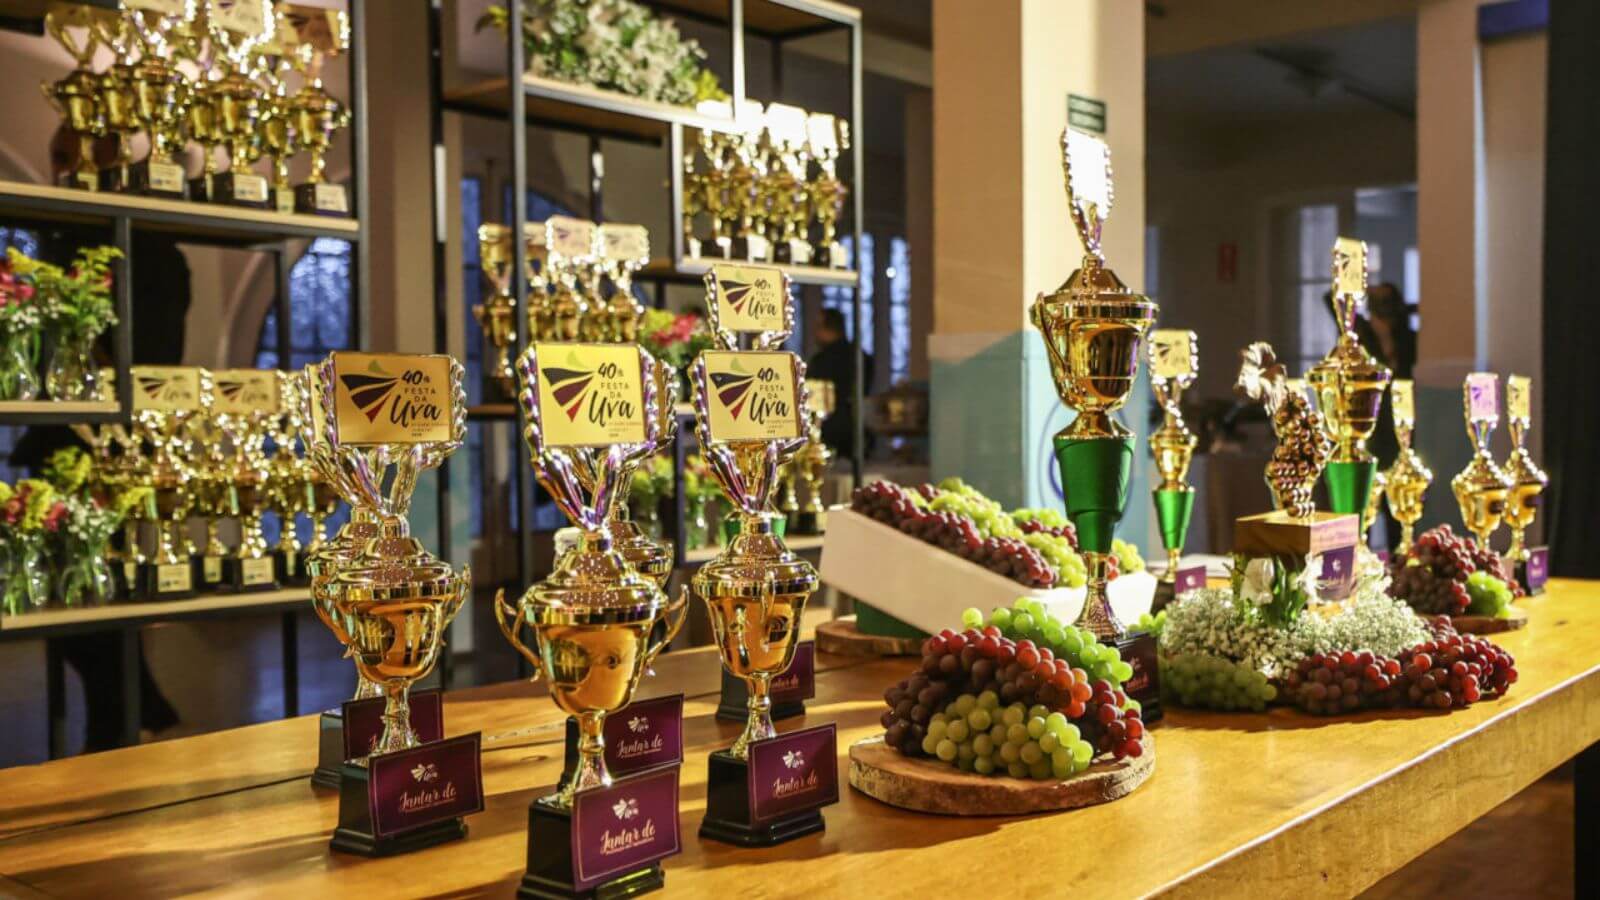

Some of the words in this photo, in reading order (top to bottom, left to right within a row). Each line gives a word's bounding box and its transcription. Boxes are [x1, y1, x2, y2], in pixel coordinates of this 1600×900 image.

[748, 295, 777, 320] Uva
[404, 387, 436, 395] FESTA
[600, 382, 629, 390] FESTA
[760, 384, 784, 392] FESTA
[414, 395, 427, 403] DA
[609, 391, 622, 399] DA
[390, 394, 442, 429] Uva
[588, 390, 636, 427] Uva
[750, 391, 790, 424] Uva
[600, 827, 639, 855] Jantar
[641, 818, 656, 838] de
